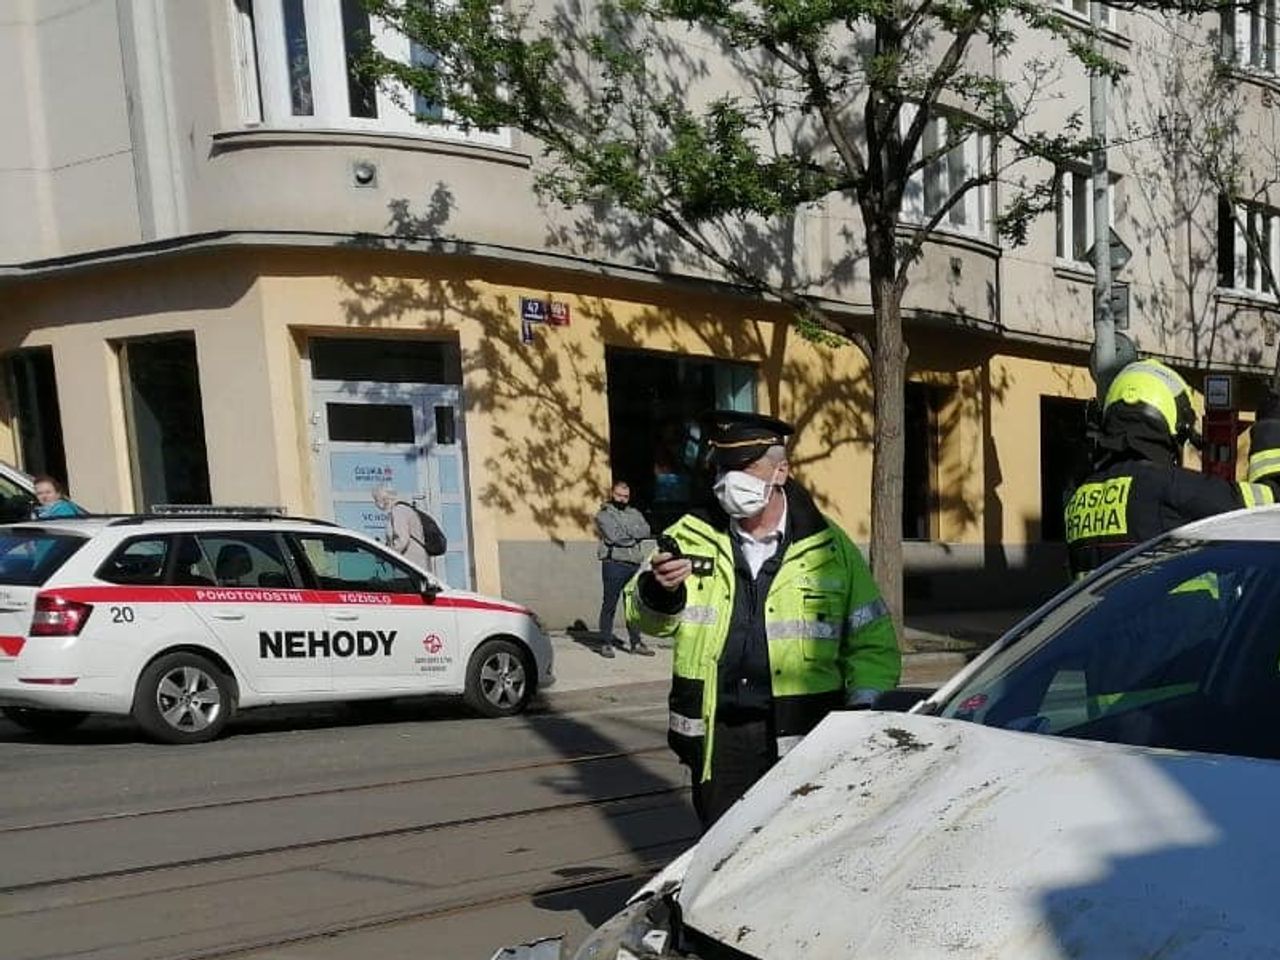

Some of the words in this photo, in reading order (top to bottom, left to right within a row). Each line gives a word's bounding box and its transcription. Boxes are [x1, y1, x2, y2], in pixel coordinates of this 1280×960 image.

[338, 593, 392, 604] VOZIDLO
[110, 606, 135, 623] 20
[258, 630, 398, 659] NEHODY
